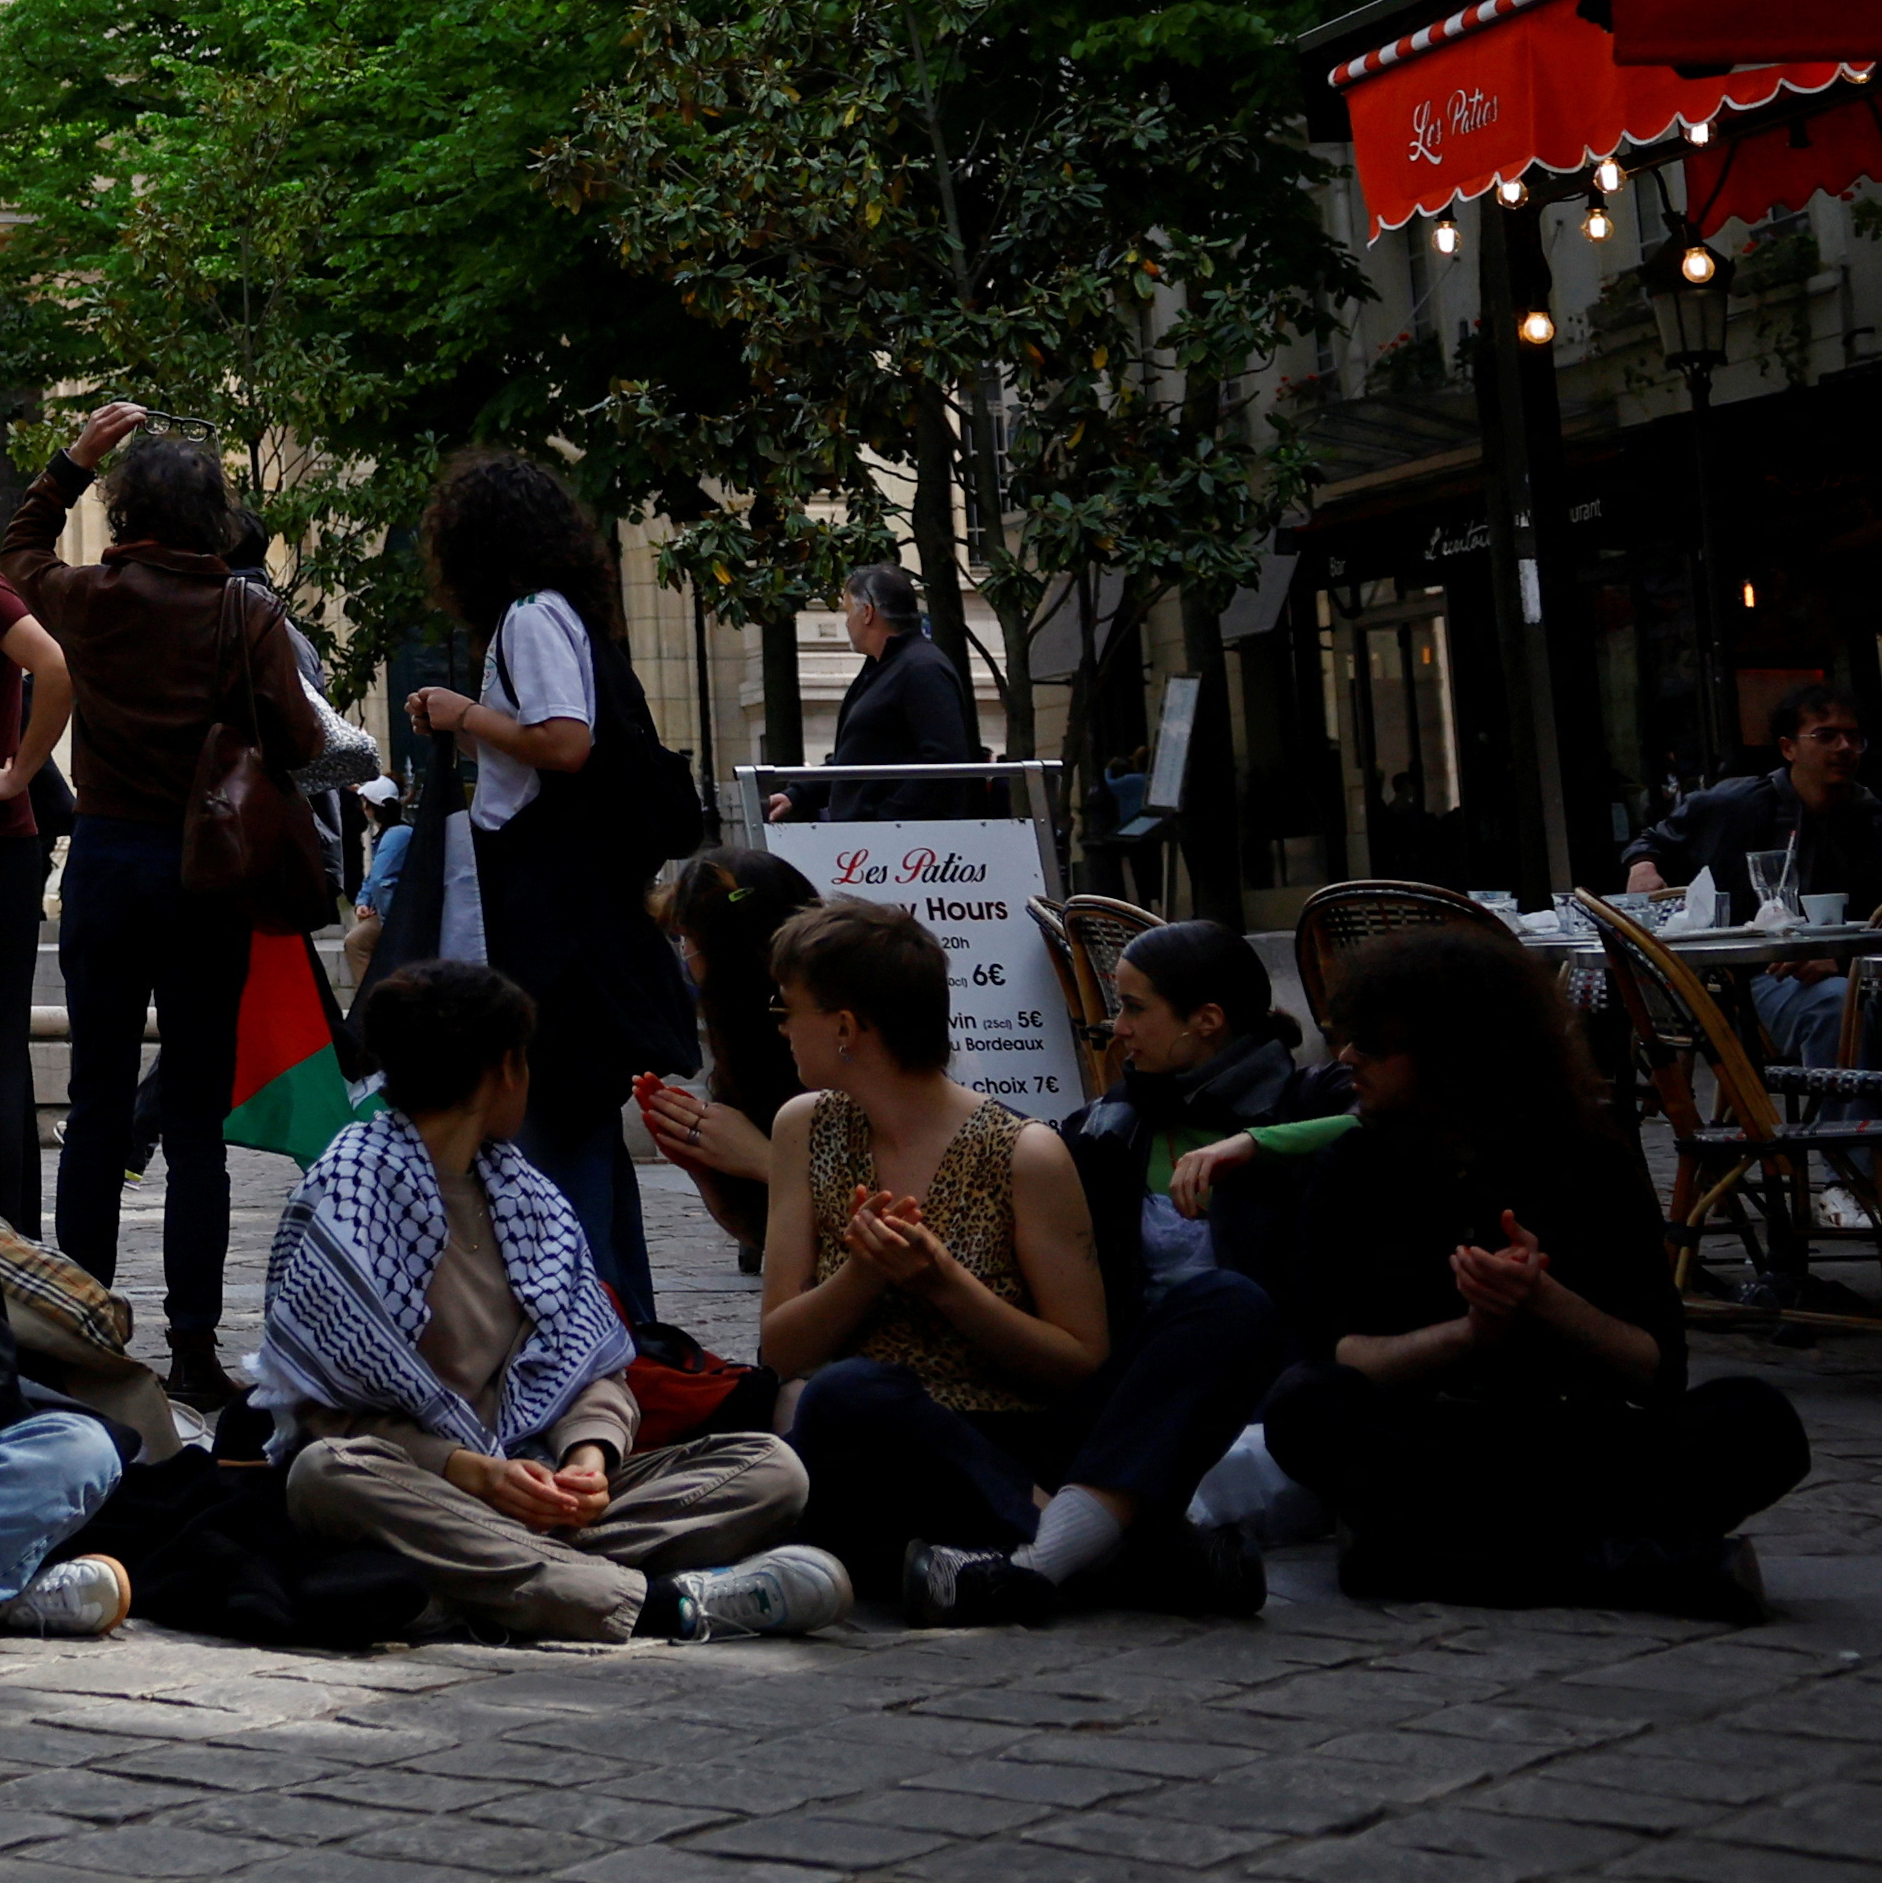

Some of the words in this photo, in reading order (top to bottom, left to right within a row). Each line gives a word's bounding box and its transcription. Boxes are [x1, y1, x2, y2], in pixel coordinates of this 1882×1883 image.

[1408, 100, 1442, 165] Les
[831, 848, 888, 885] Les
[895, 847, 987, 884] Patios
[926, 897, 1008, 921] Hours
[942, 936, 970, 949] 20h
[972, 963, 1006, 987] 6€
[947, 1012, 977, 1029] vin
[983, 1019, 1012, 1031] (25cl)
[1018, 1010, 1044, 1028] 5€
[965, 1037, 1044, 1052] Bordeaux
[972, 1077, 1029, 1095] choix
[1033, 1075, 1060, 1094] 7€
